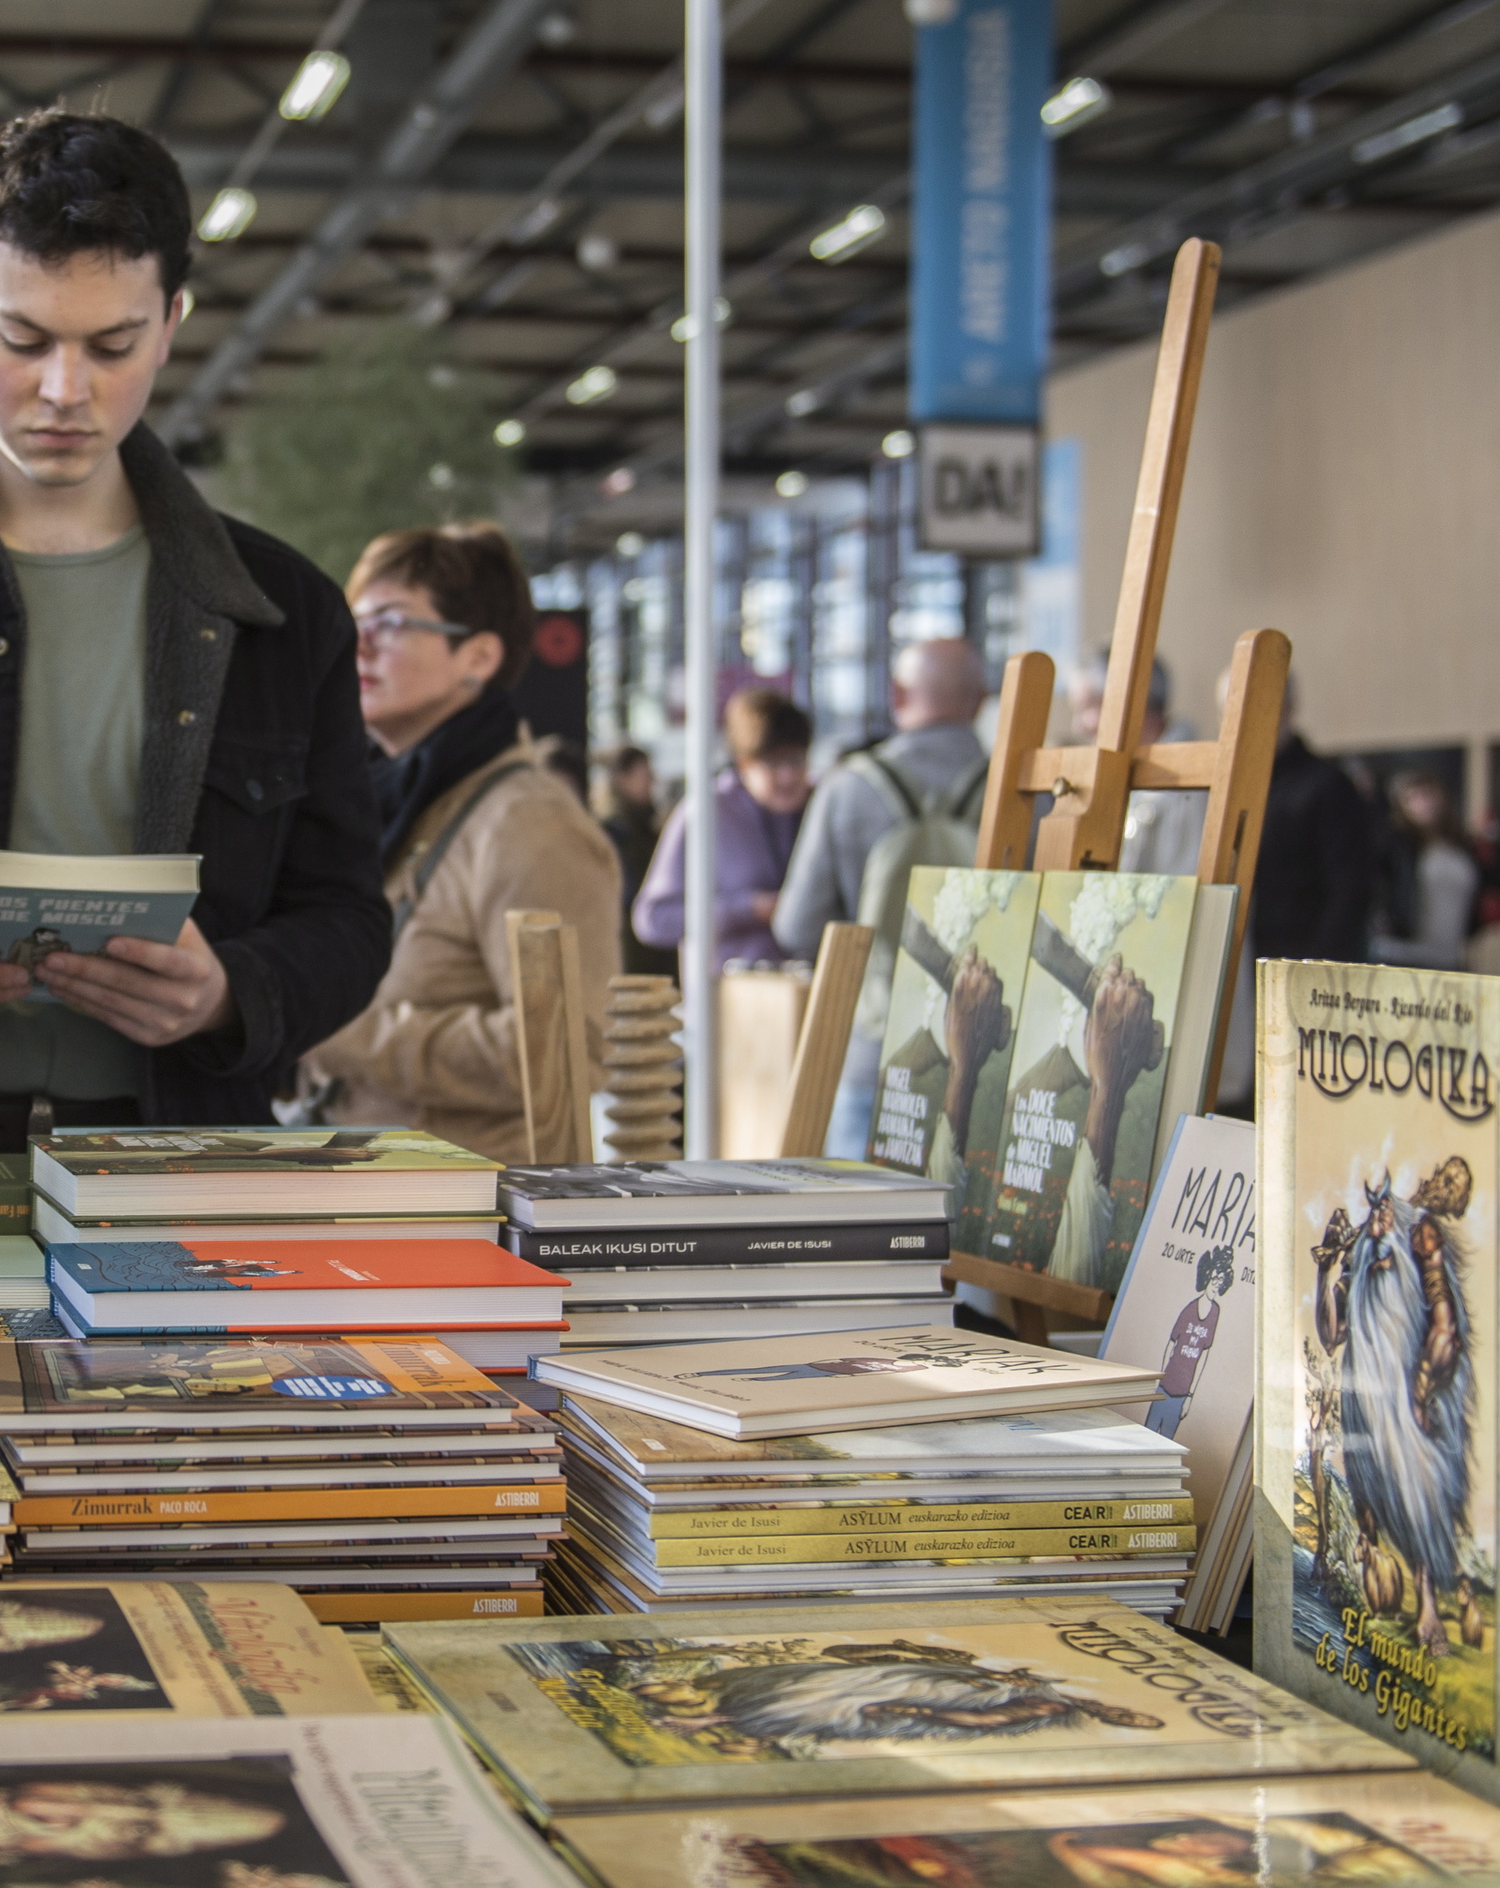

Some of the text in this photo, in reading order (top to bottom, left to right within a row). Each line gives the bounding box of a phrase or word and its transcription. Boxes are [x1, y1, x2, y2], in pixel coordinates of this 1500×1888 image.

[0, 909, 30, 923] DE
[38, 898, 150, 914] PUENTES
[1297, 1026, 1494, 1122] MITOLOGIKA
[1027, 1088, 1057, 1118] DOCE
[539, 1235, 926, 1256] BALEAK IKUSI DITUT JAVIER DE ISUSI ASTIBERRI
[1161, 1242, 1173, 1260] 20
[71, 1491, 540, 1517] Zimurrak PACO ROCA ASTIBERRI
[690, 1516, 729, 1531] Javier
[732, 1516, 746, 1529] de
[749, 1514, 781, 1529] Isusi
[908, 1509, 970, 1525] euskarazko
[973, 1508, 1010, 1523] edizioa
[1122, 1503, 1173, 1520] ASTIBERRI
[697, 1544, 735, 1559] Javier
[738, 1543, 752, 1557] de
[755, 1541, 787, 1556] Isusi
[913, 1537, 975, 1553] euskarazko
[978, 1536, 1016, 1551] edizioa
[1127, 1531, 1178, 1549] ASTIBERRI
[472, 1598, 518, 1614] ASTIBERRI
[1341, 1607, 1437, 1687] El mundo
[1315, 1632, 1467, 1750] de los Gigantes
